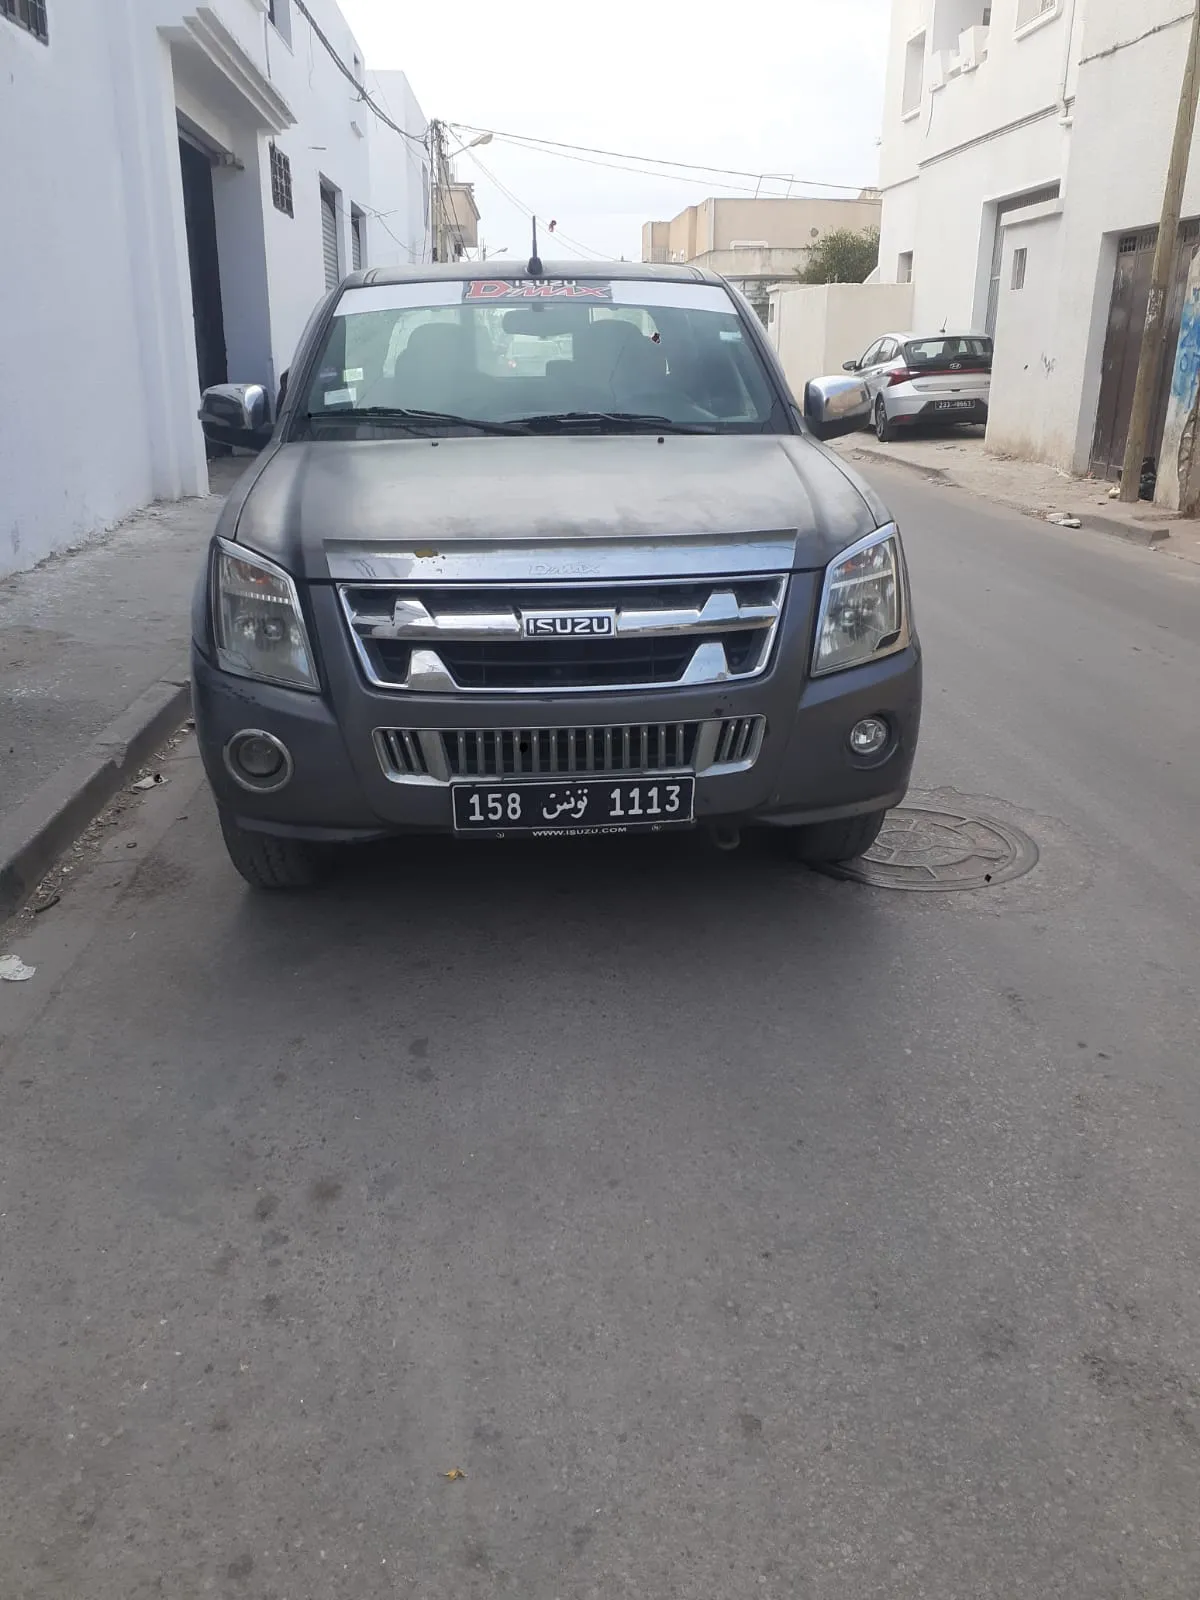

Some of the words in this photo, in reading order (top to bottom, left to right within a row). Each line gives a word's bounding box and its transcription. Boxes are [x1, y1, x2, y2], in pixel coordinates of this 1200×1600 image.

[529, 618, 609, 634] ISUZU
[469, 794, 522, 821] 158
[542, 788, 588, 819] تونس
[610, 785, 681, 816] 1113
